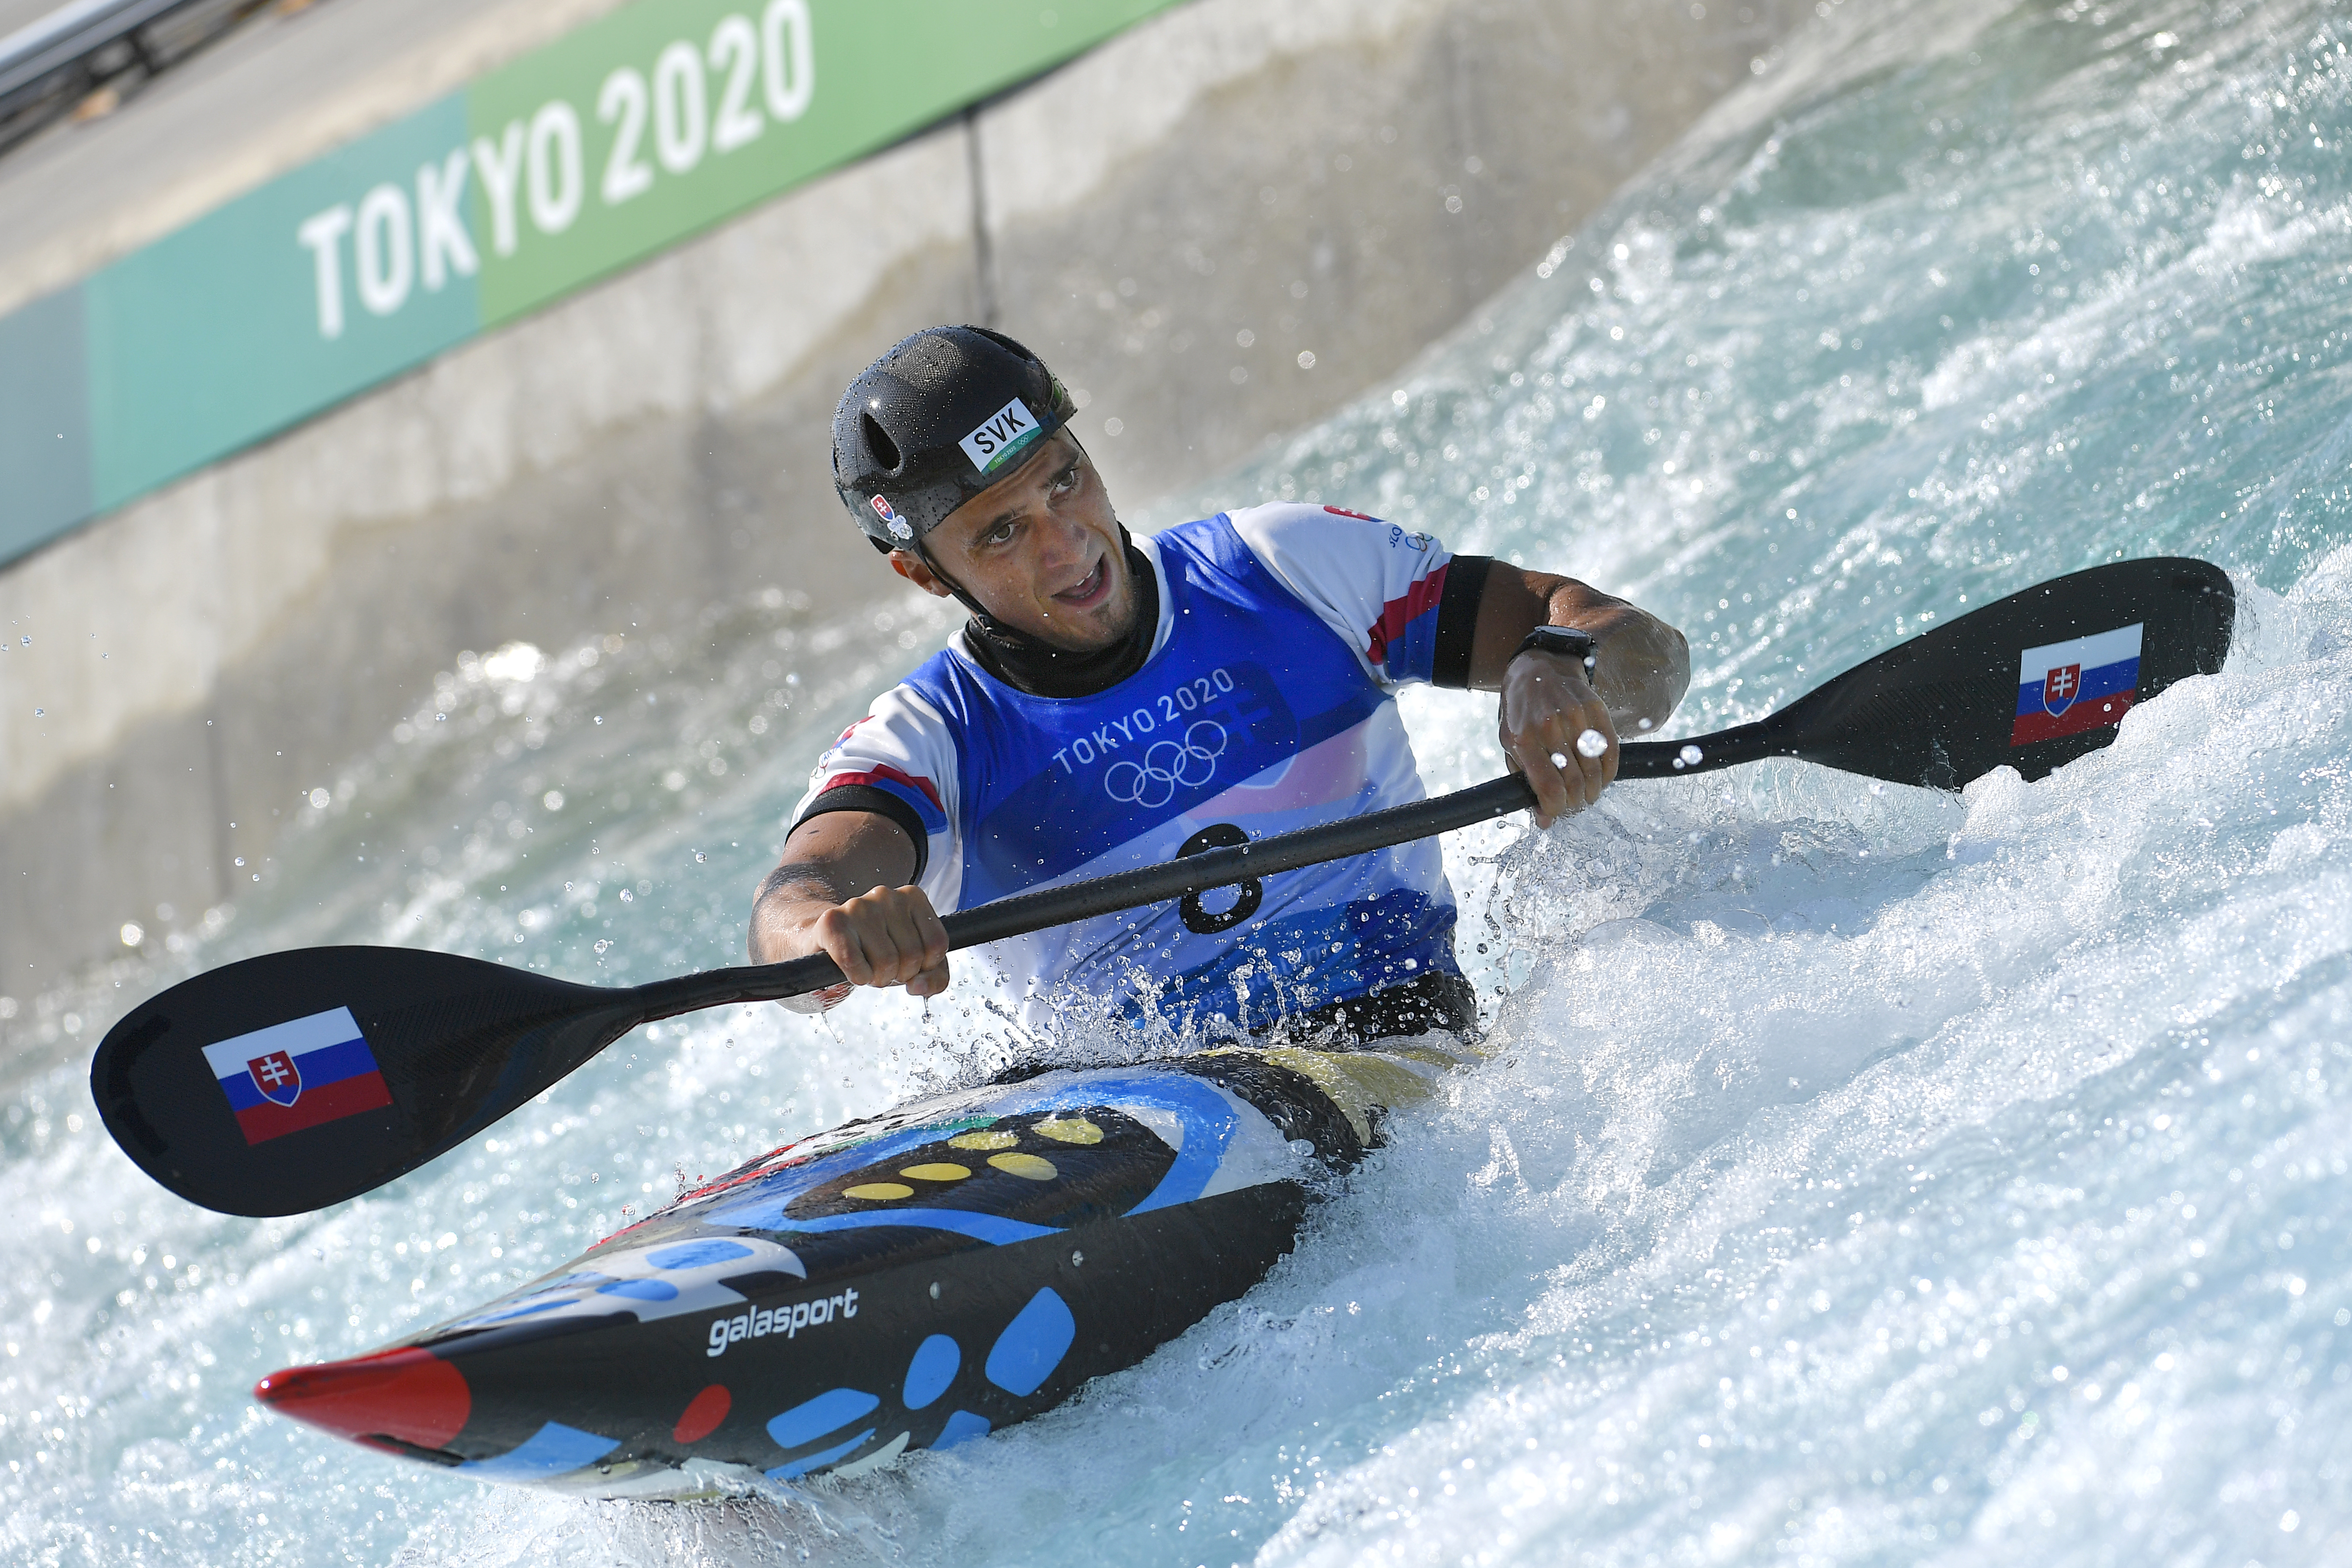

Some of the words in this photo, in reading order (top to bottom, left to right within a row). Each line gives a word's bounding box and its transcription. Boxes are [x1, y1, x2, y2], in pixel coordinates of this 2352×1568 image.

[297, 99, 585, 340] TOKYO
[595, 0, 815, 206] 2020
[974, 407, 1026, 454] SVK
[994, 452, 1007, 463] TOKYO
[1006, 445, 1016, 455] 2020
[1052, 708, 1155, 774] TOKYO
[1157, 668, 1234, 721] 2020
[706, 1287, 859, 1358] galasport
